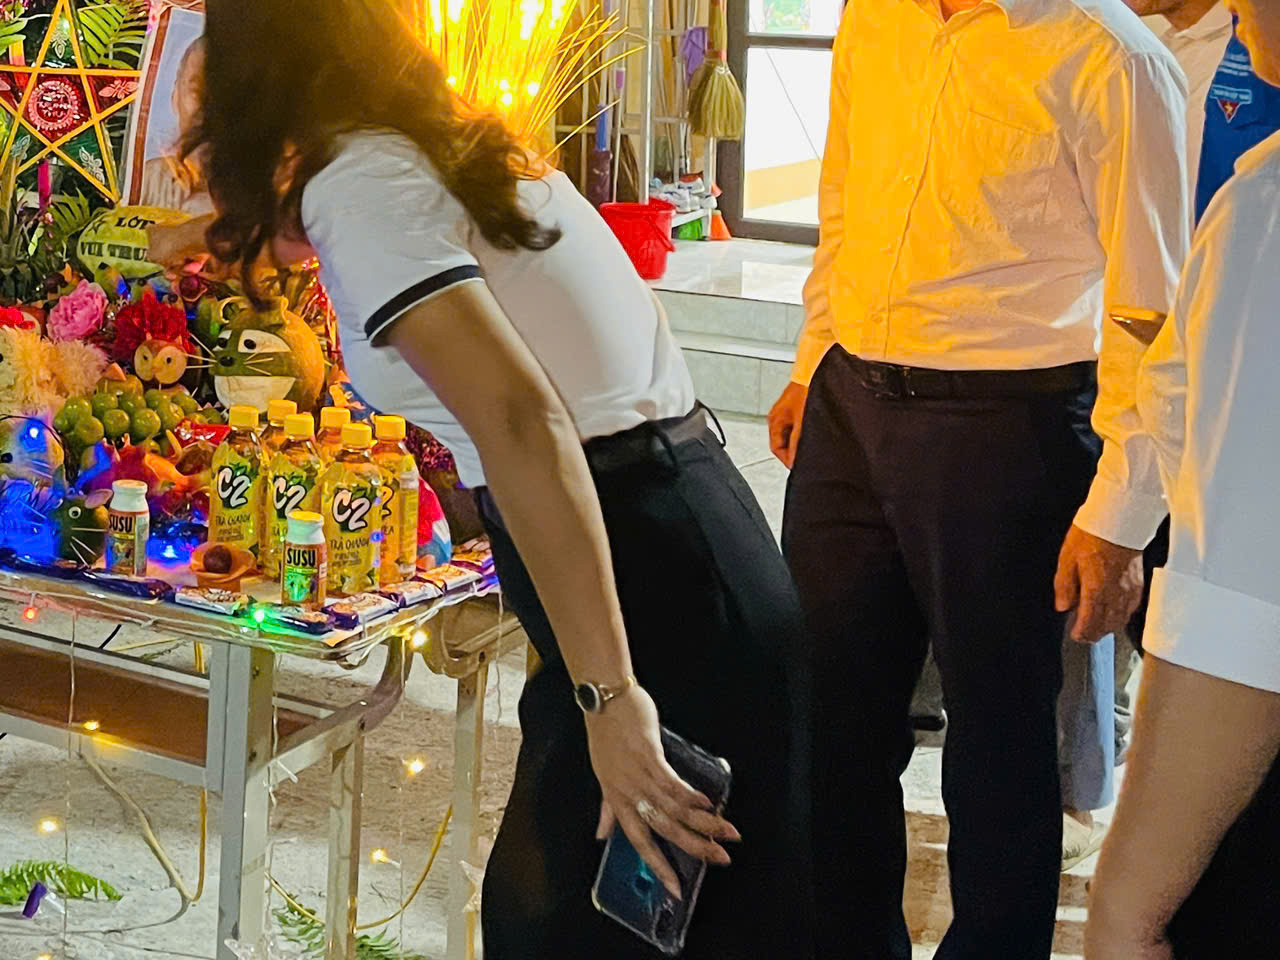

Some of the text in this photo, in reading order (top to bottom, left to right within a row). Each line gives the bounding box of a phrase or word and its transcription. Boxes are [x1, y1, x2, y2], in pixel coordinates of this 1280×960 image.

[81, 242, 147, 261] VUI TRU
[218, 466, 250, 509] C2
[273, 476, 306, 516] C2
[332, 487, 372, 532] C2
[287, 548, 317, 568] SUSU
